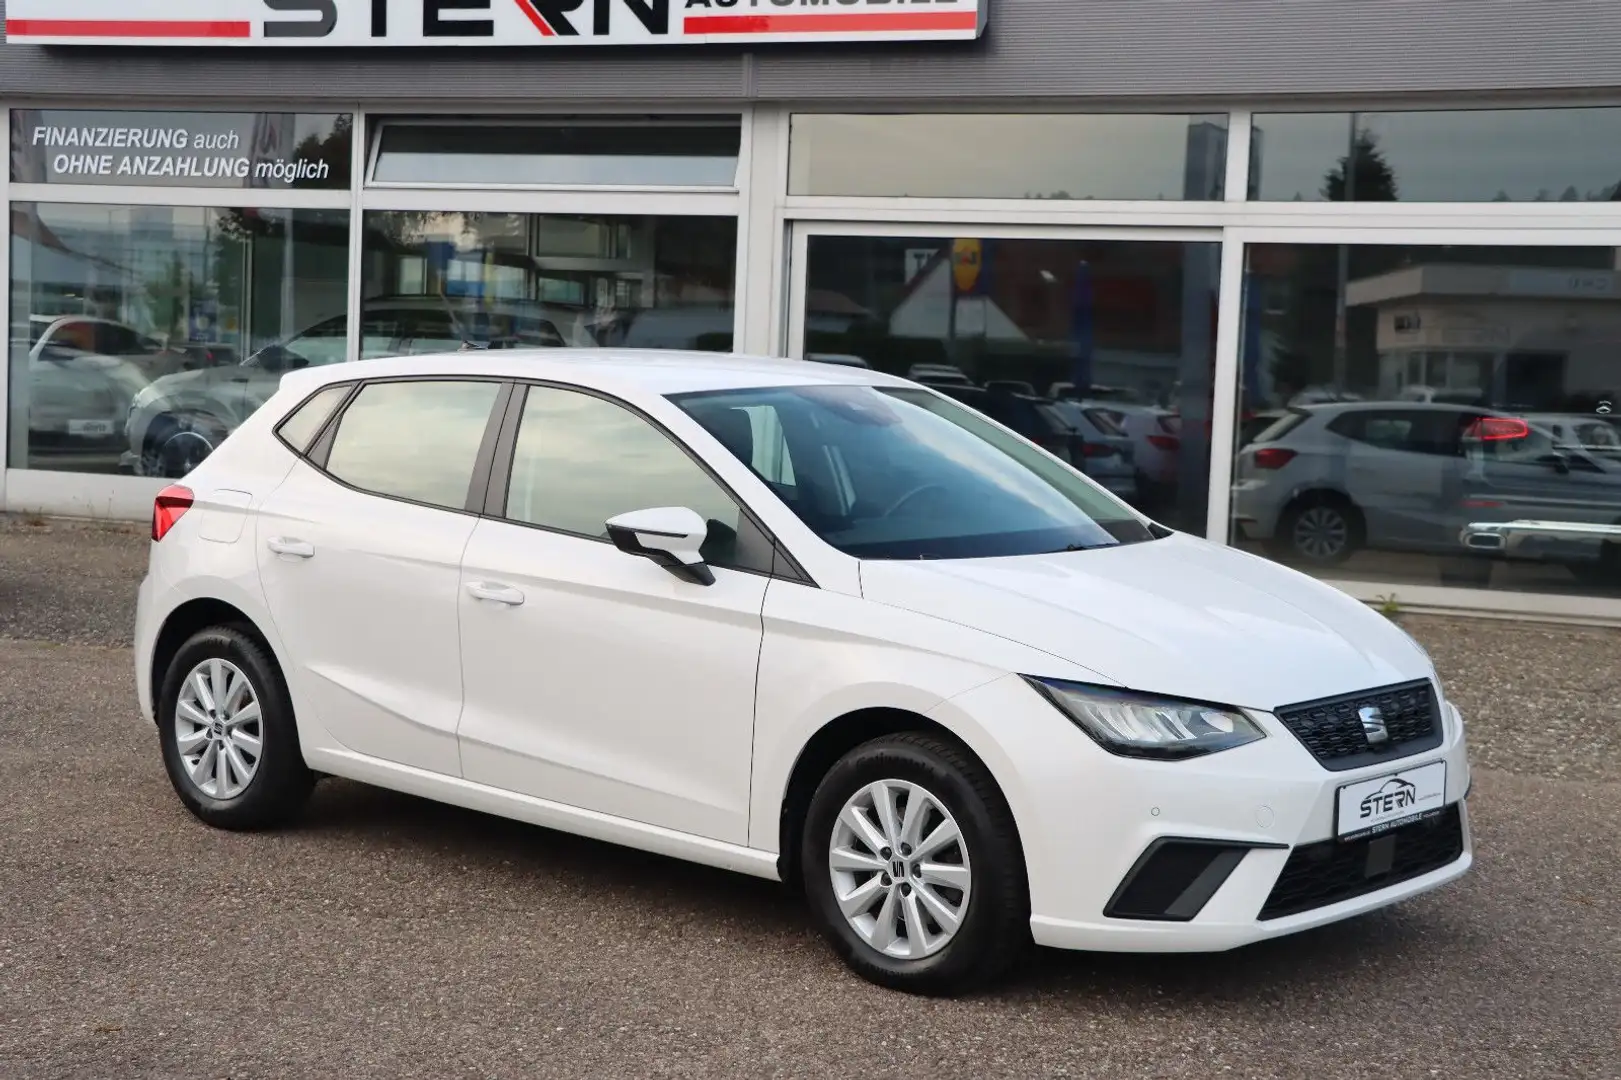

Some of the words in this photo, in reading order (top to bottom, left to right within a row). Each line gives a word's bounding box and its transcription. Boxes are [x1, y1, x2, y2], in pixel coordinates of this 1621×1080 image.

[32, 126, 188, 149] FINANZIERUNG
[193, 130, 239, 149] auch
[53, 154, 113, 174] OHNE
[117, 156, 249, 178] ANZAHLUNG
[254, 159, 329, 183] möglich
[1360, 788, 1416, 818] STERN
